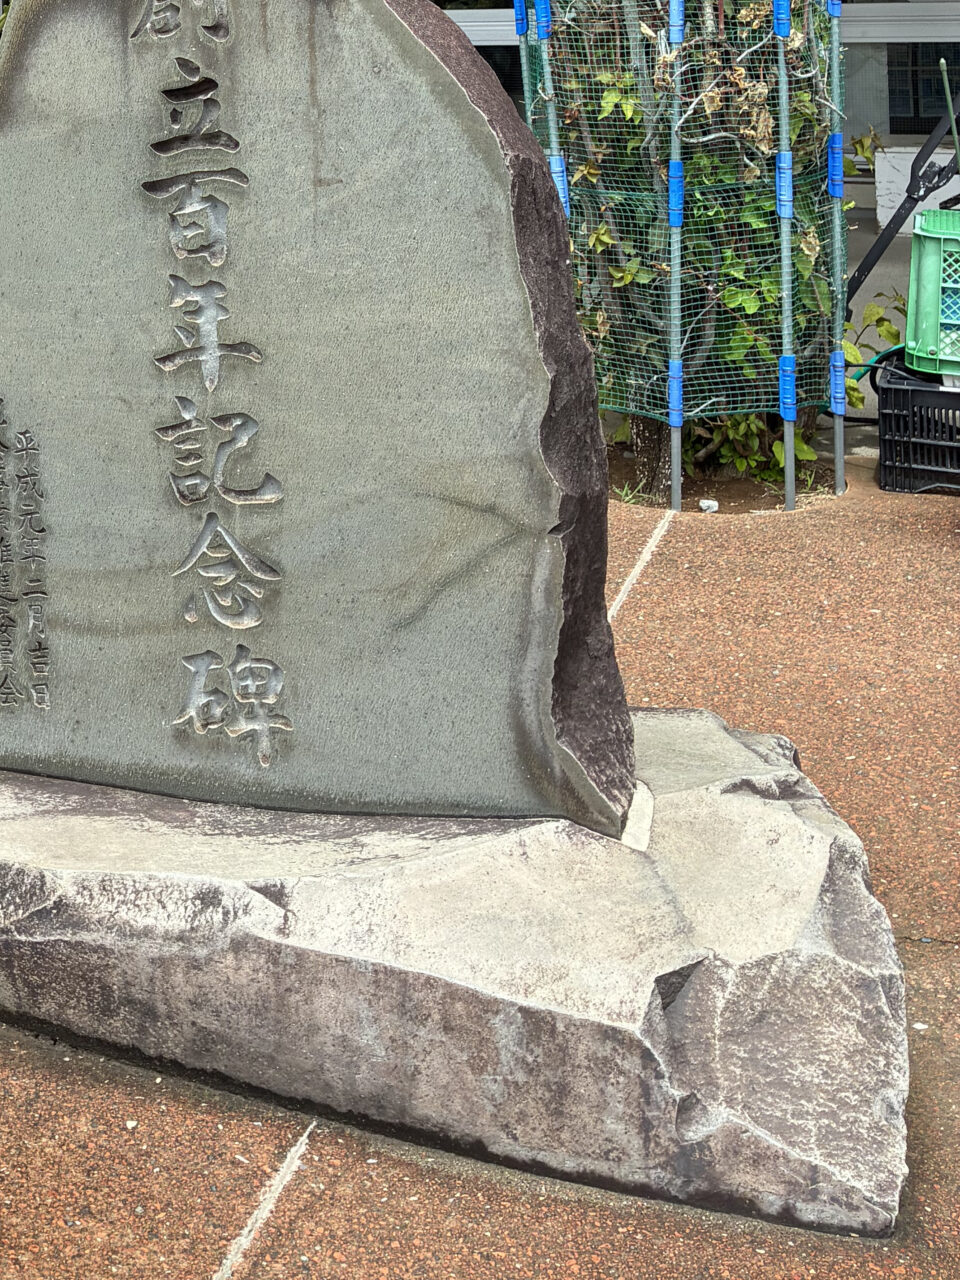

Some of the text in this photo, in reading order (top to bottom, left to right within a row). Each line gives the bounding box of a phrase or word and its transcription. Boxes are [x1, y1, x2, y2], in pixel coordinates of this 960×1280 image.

[13, 429, 50, 709] 平成元年二月吉日
